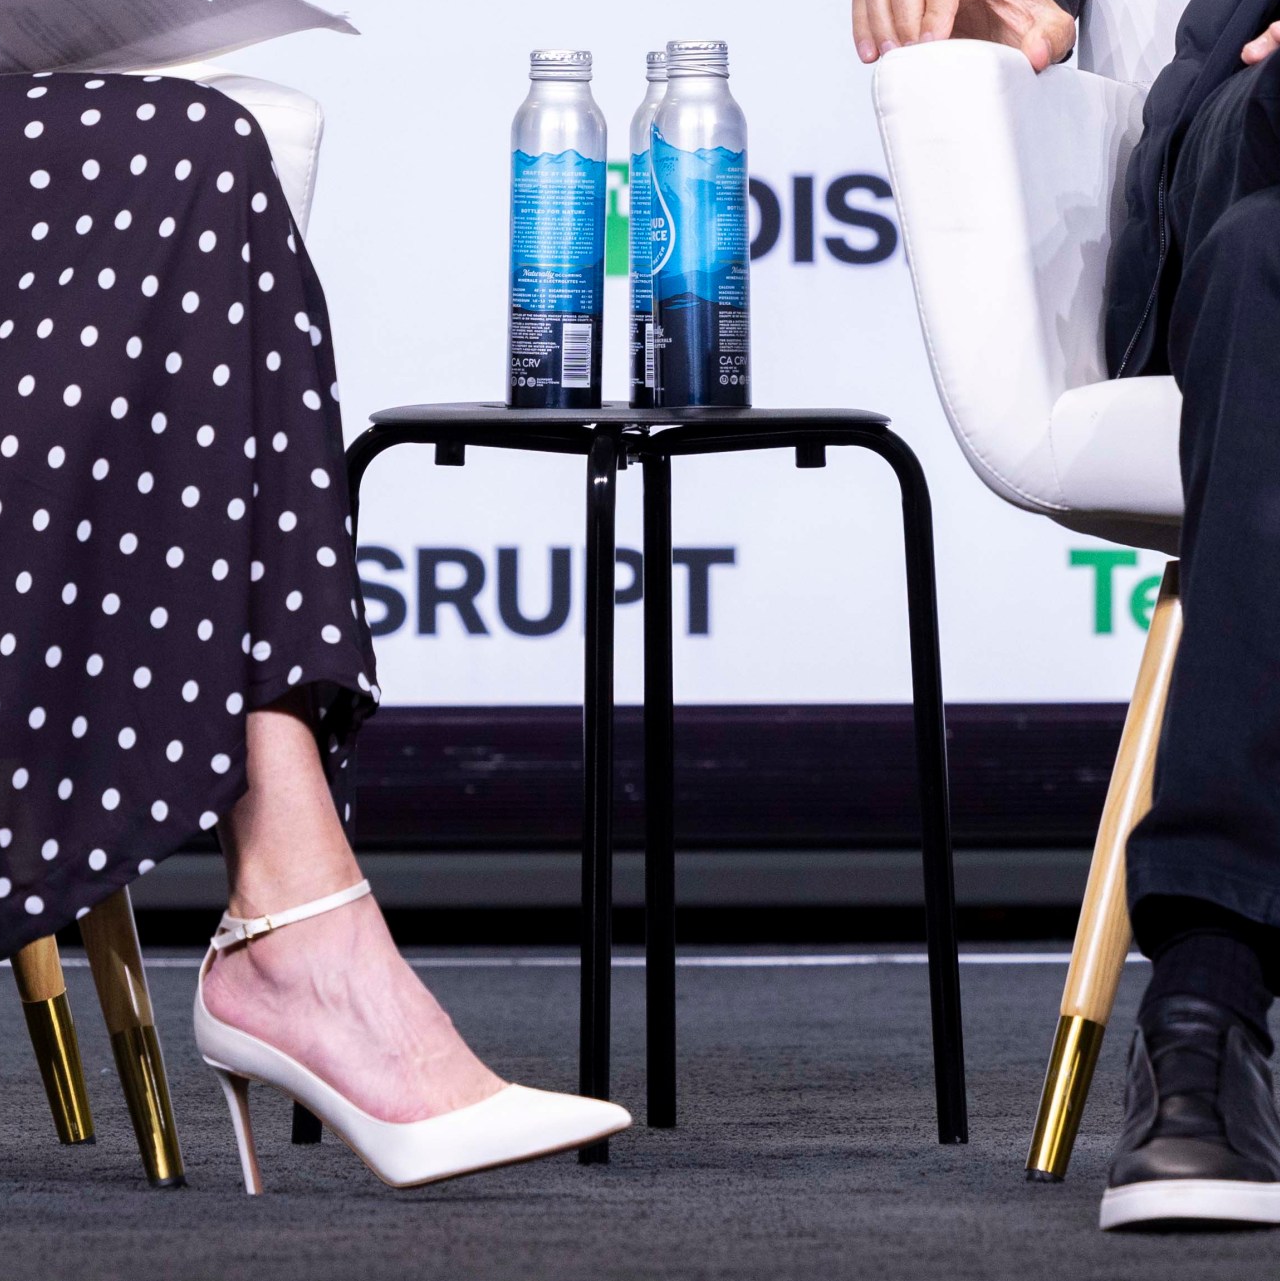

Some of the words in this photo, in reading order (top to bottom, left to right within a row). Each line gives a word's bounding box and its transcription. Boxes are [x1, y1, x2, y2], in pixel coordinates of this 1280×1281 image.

[523, 269, 554, 280] Naturally
[522, 358, 541, 368] CRV
[719, 356, 733, 366] CA
